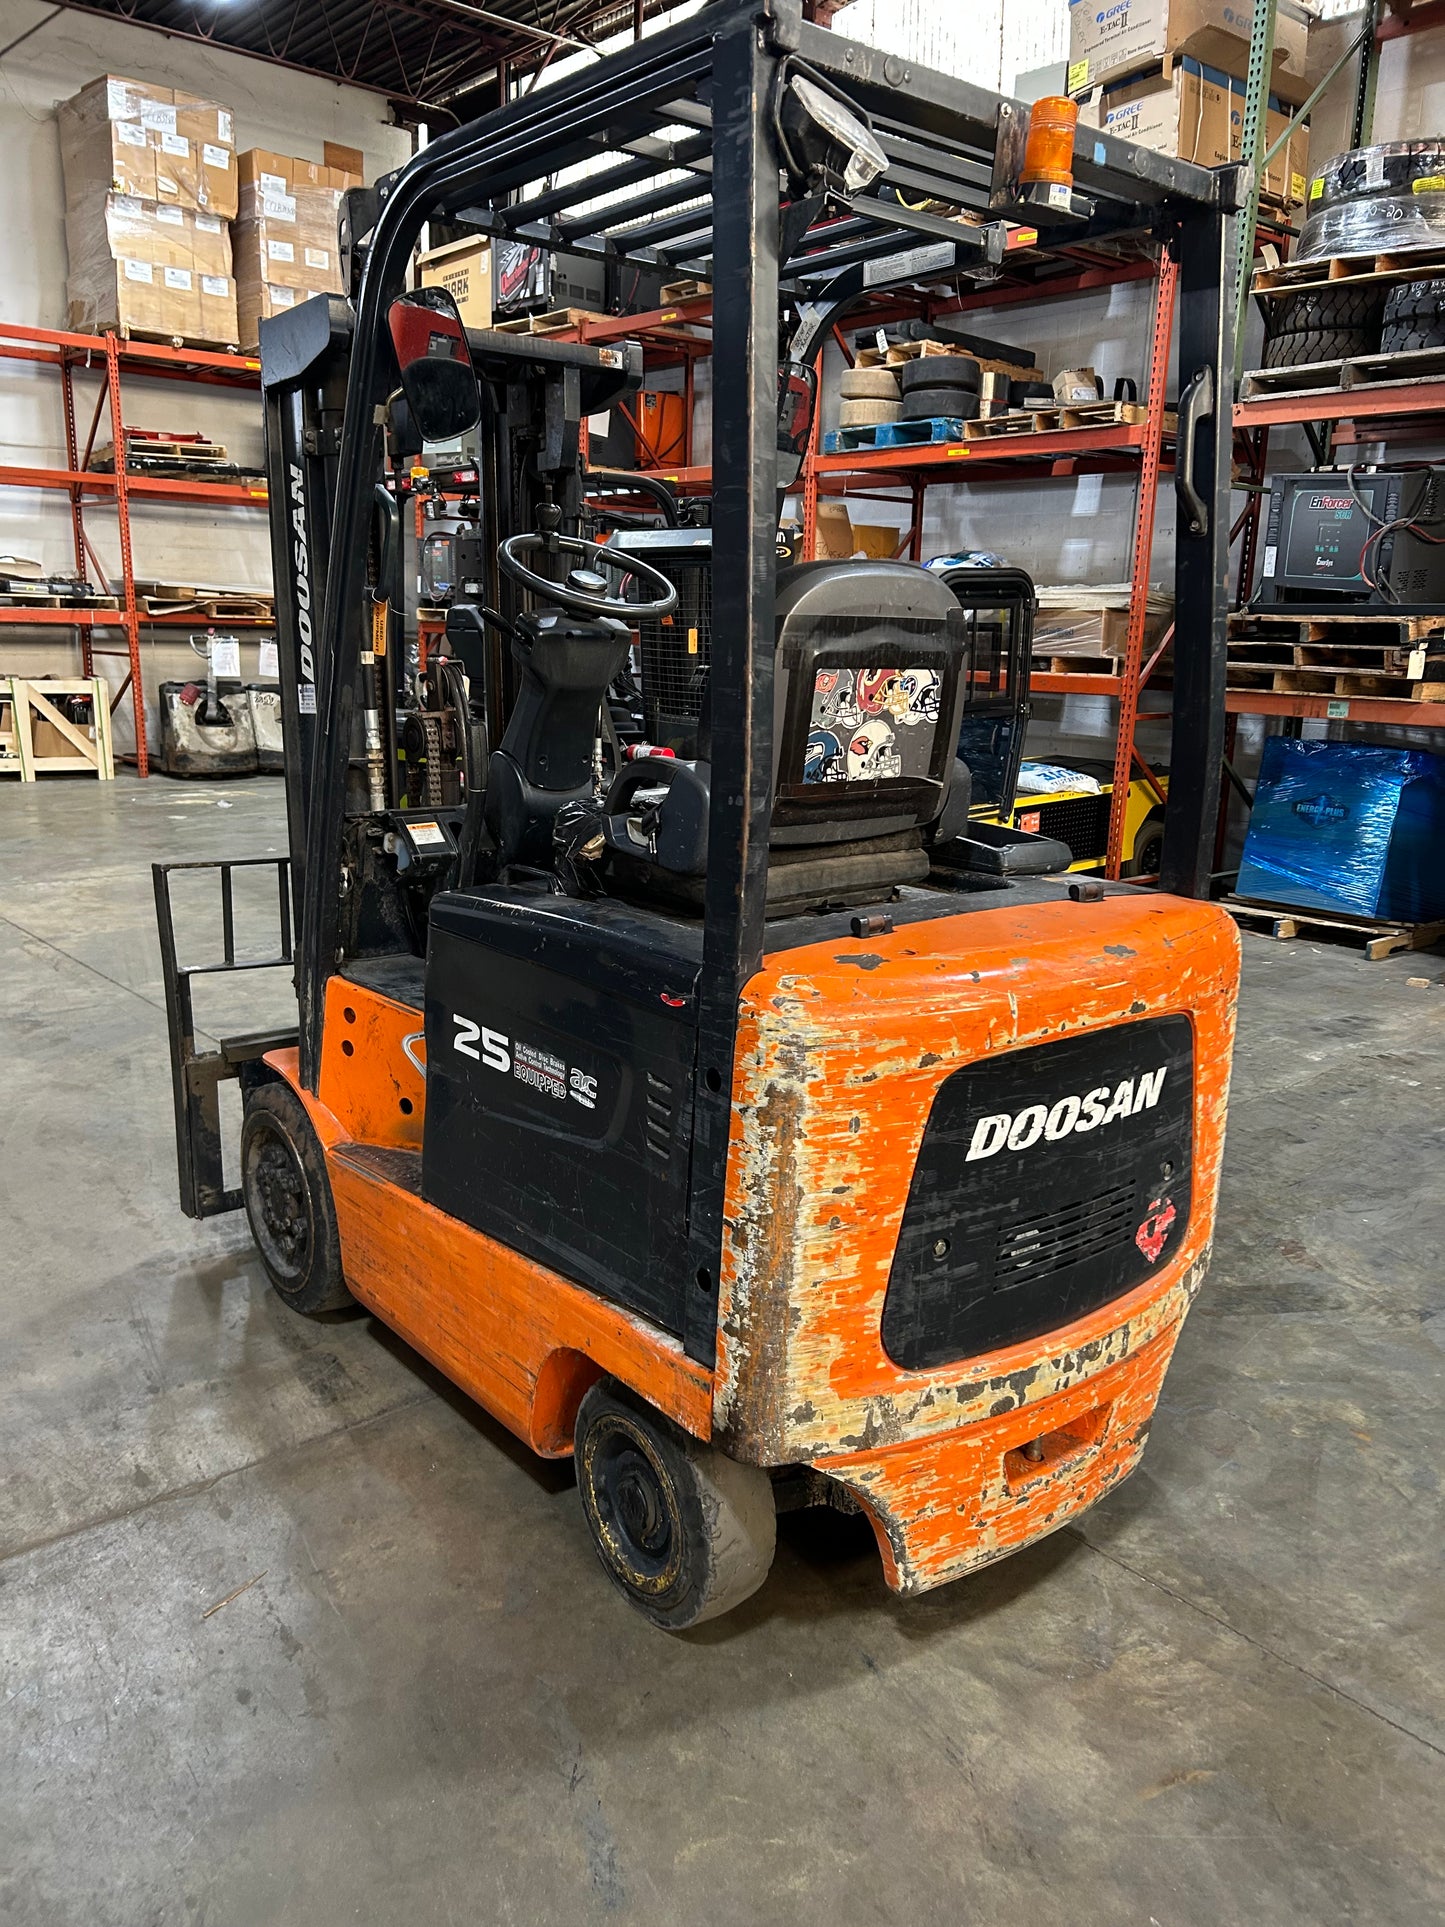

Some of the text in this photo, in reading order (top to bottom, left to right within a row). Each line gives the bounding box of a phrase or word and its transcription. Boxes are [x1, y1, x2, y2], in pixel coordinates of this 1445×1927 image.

[1106, 0, 1132, 19] GREE
[1083, 40, 1104, 54] Engineered
[1127, 18, 1152, 32] Conditioner
[1100, 17, 1120, 35] E-TAC
[1115, 101, 1144, 121] GREE
[1109, 119, 1131, 135] E-TAC
[1138, 122, 1163, 135] Conditioner
[1308, 495, 1354, 510] EnForcer
[290, 463, 315, 683] DOOSAN
[453, 1013, 511, 1073] 25
[515, 1050, 566, 1081] Active Control Technology
[522, 1046, 537, 1059] Cooled
[538, 1052, 549, 1064] Disc
[549, 1057, 566, 1071] Brakes
[514, 1061, 567, 1099] EQUIPPED
[965, 1066, 1168, 1163] DOOSAN
